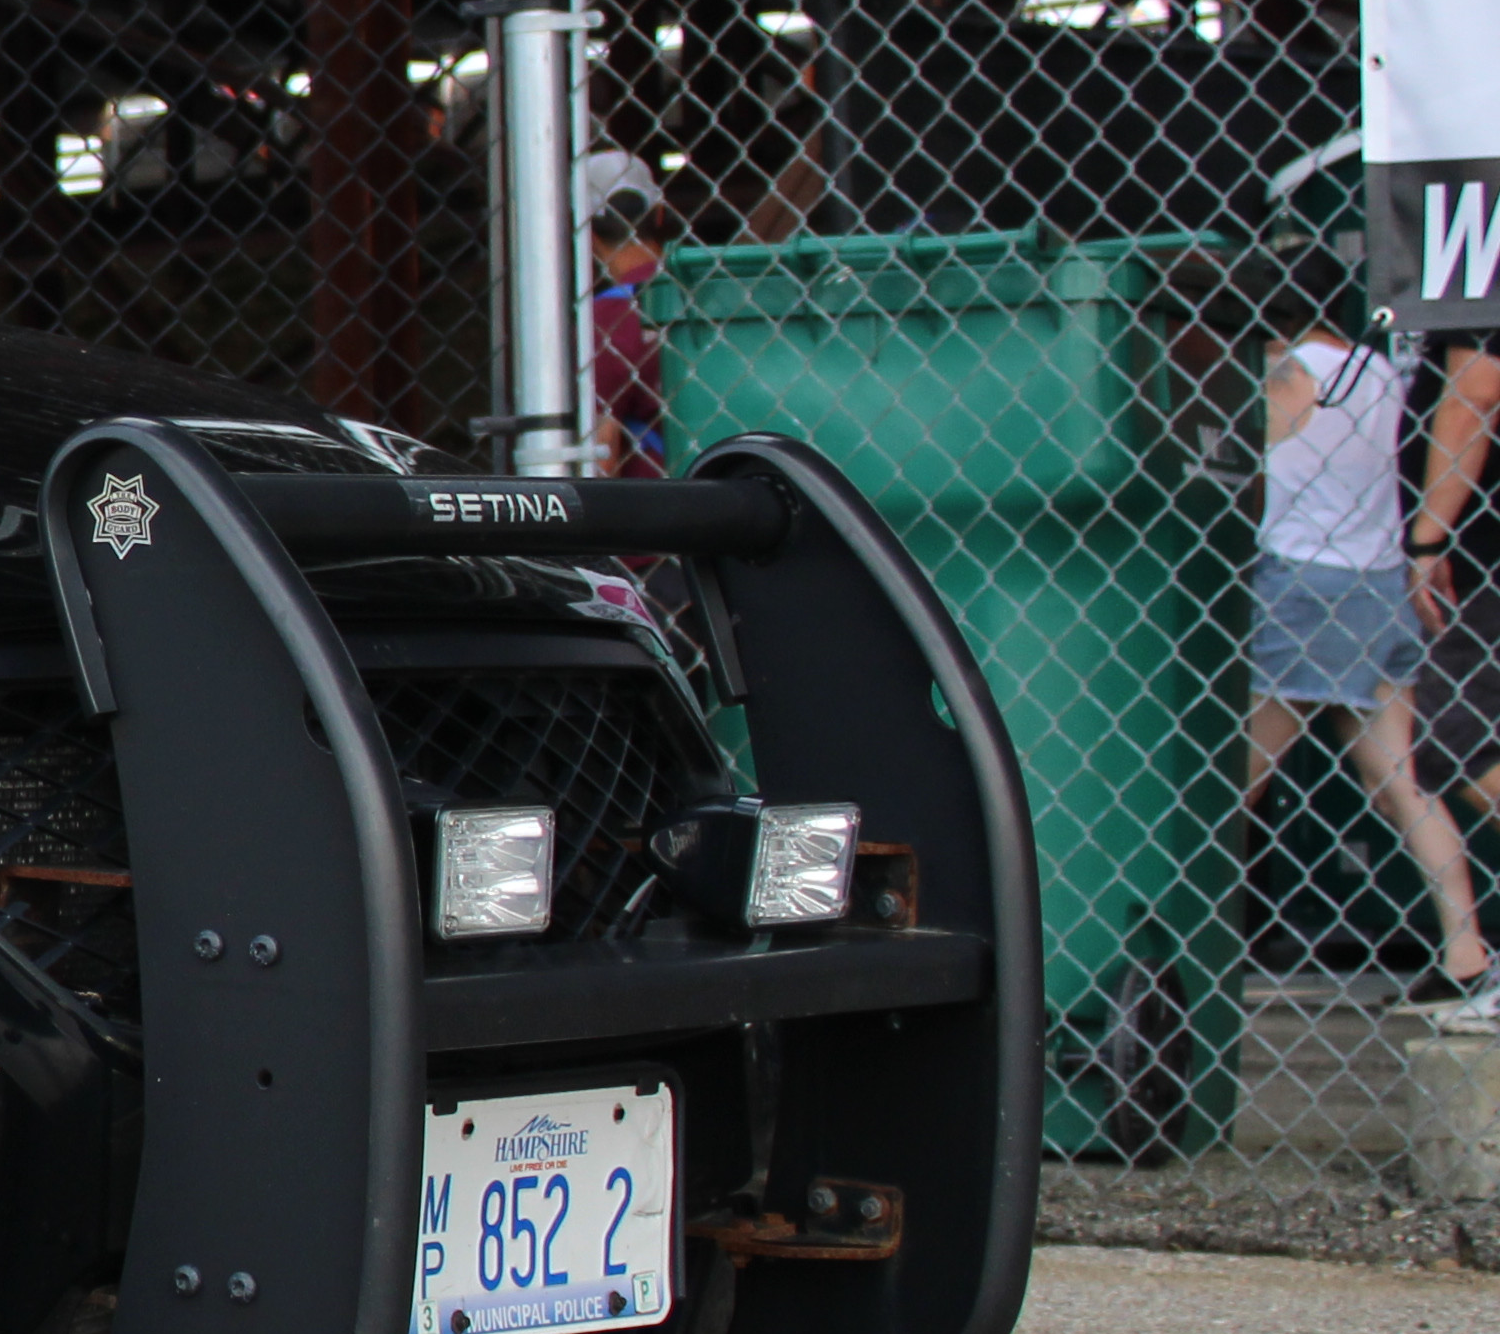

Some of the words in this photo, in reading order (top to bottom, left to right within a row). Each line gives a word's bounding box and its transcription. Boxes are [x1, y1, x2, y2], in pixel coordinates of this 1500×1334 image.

[110, 504, 137, 516] BODY
[429, 493, 569, 523] SETINA
[107, 523, 139, 534] GUARD
[513, 1113, 572, 1137] New
[494, 1129, 589, 1162] HAMPSHIRE
[509, 1162, 523, 1173] LIVE
[524, 1161, 543, 1172] FREE
[545, 1160, 555, 1170] OR
[556, 1159, 568, 1169] DIE
[478, 1173, 570, 1291] 852
[603, 1166, 633, 1277] 2
[422, 1305, 433, 1332] 3
[468, 1303, 551, 1334] MUNICIPAL
[554, 1295, 604, 1320] POLICE
